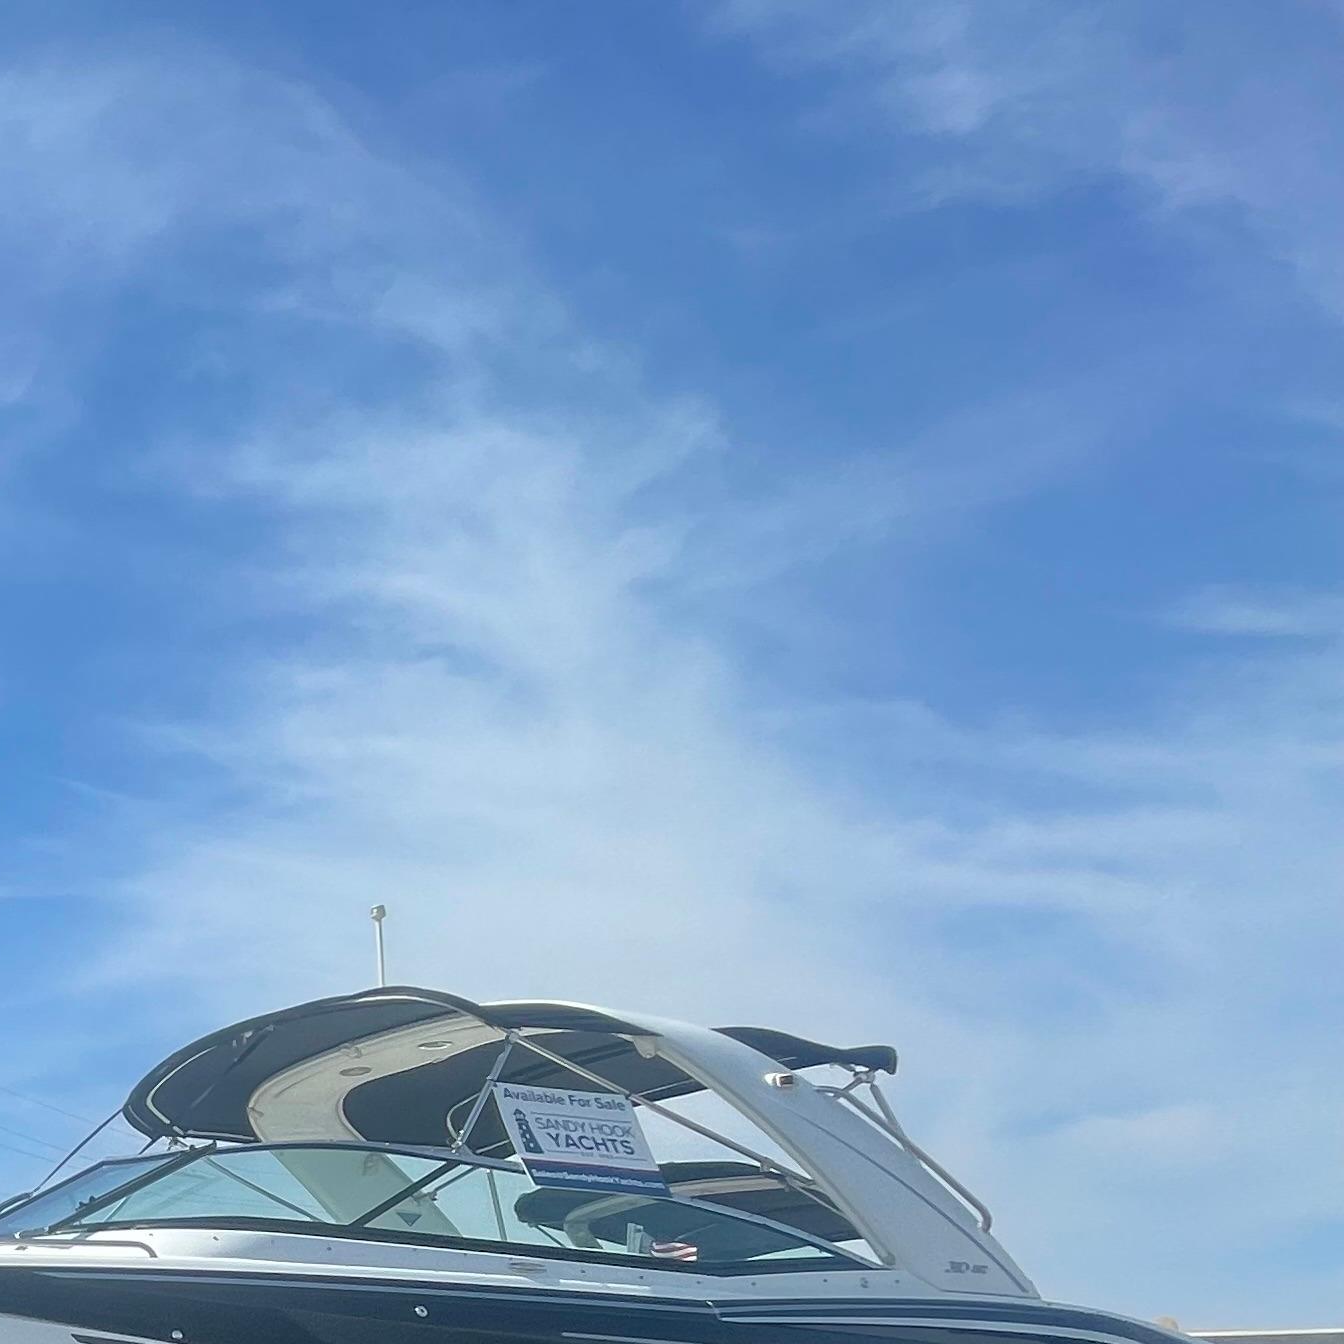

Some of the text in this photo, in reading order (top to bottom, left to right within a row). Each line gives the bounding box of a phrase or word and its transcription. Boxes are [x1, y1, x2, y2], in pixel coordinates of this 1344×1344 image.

[503, 1087, 626, 1112] Available For Sale
[534, 1117, 636, 1138] SANDY HOOK
[545, 1132, 636, 1156] YACHTS
